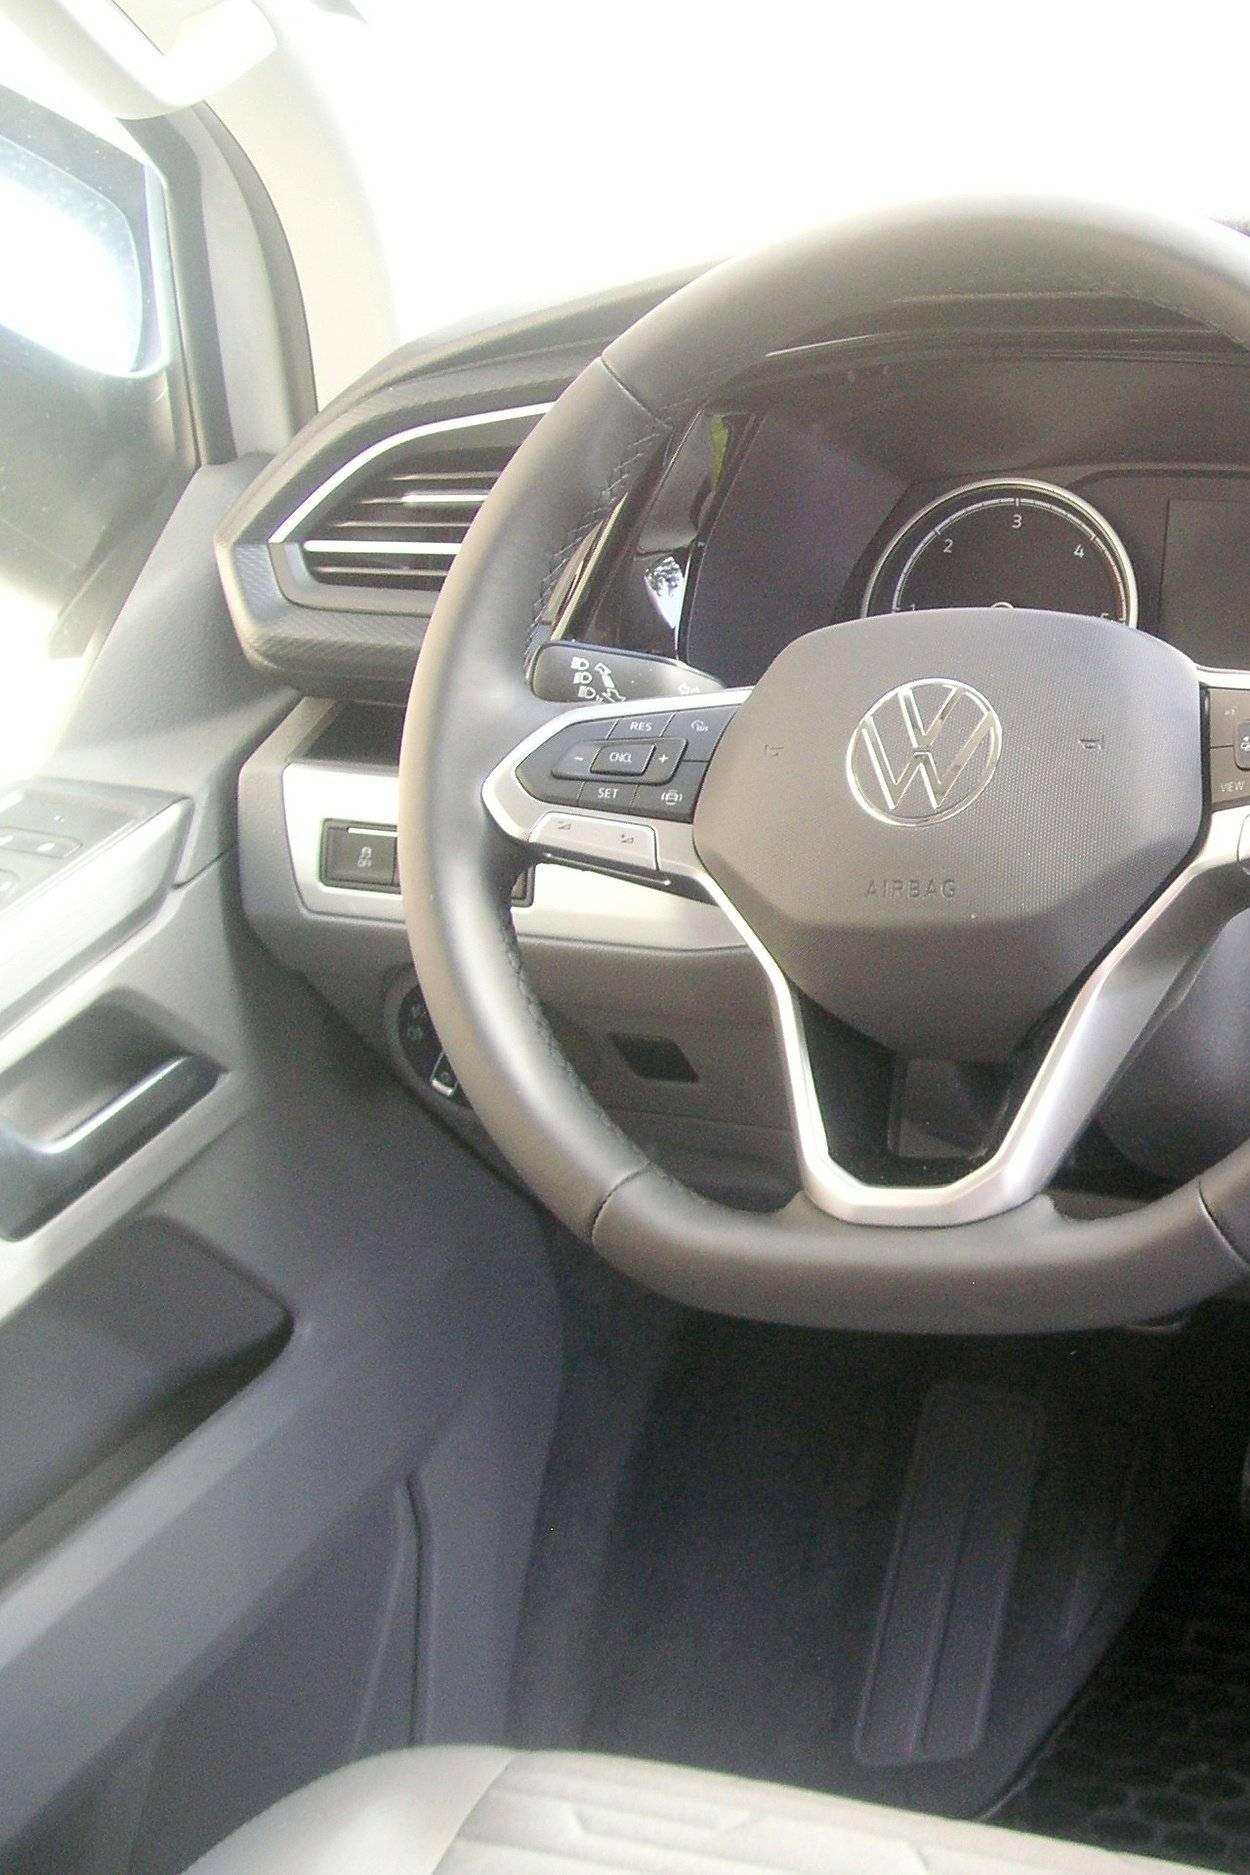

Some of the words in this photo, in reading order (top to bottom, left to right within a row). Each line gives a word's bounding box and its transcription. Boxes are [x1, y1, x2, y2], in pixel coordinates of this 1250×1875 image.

[1011, 514, 1023, 530] 3
[943, 538, 954, 554] 2
[1072, 543, 1086, 559] 4
[629, 720, 653, 732] RES
[609, 751, 633, 763] CNCL
[597, 788, 618, 800] SET
[864, 878, 956, 899] AIRBAG
